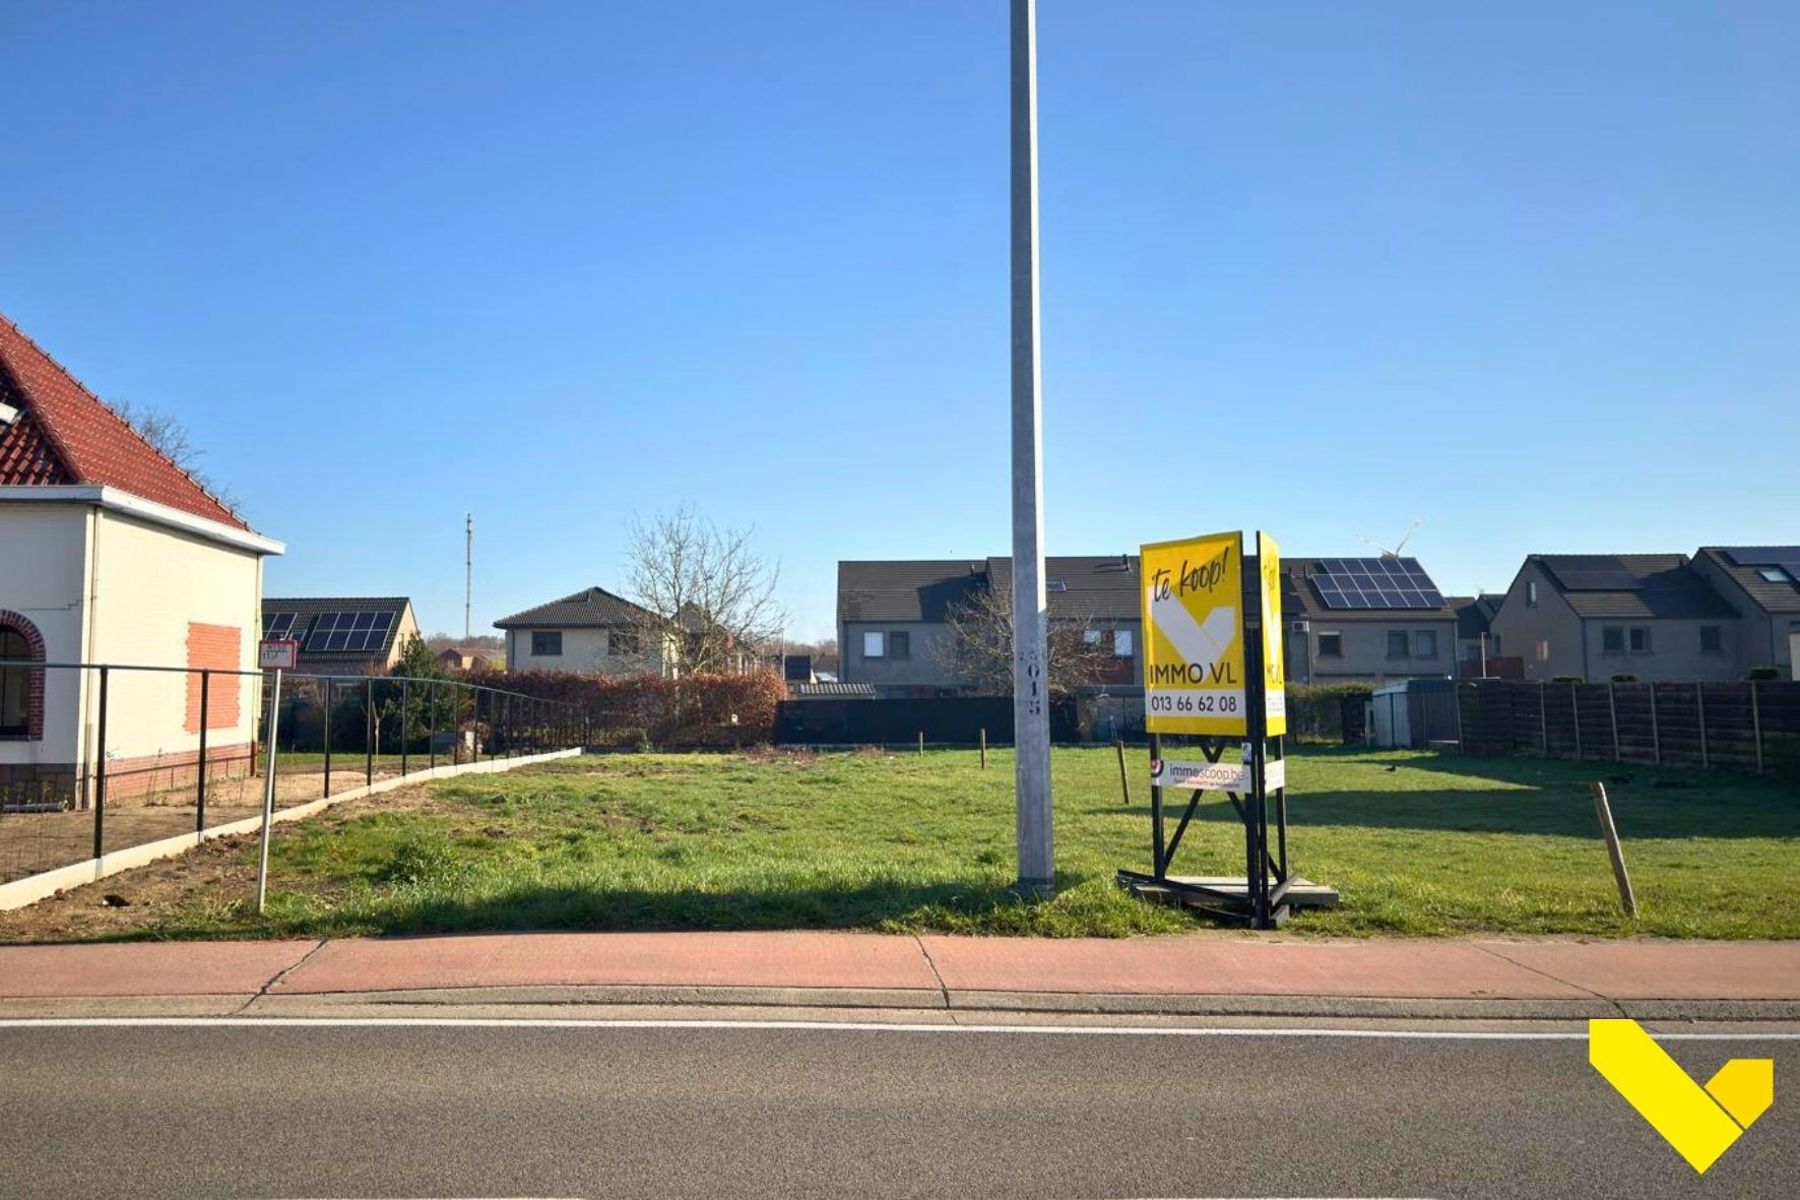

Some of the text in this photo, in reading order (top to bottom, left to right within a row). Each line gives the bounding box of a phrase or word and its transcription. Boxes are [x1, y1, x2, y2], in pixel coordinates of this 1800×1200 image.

[1151, 568, 1172, 602] te
[1178, 546, 1230, 598] koop!
[1149, 662, 1238, 685] IMMO VL
[1151, 696, 1237, 712] 013 66 62 08
